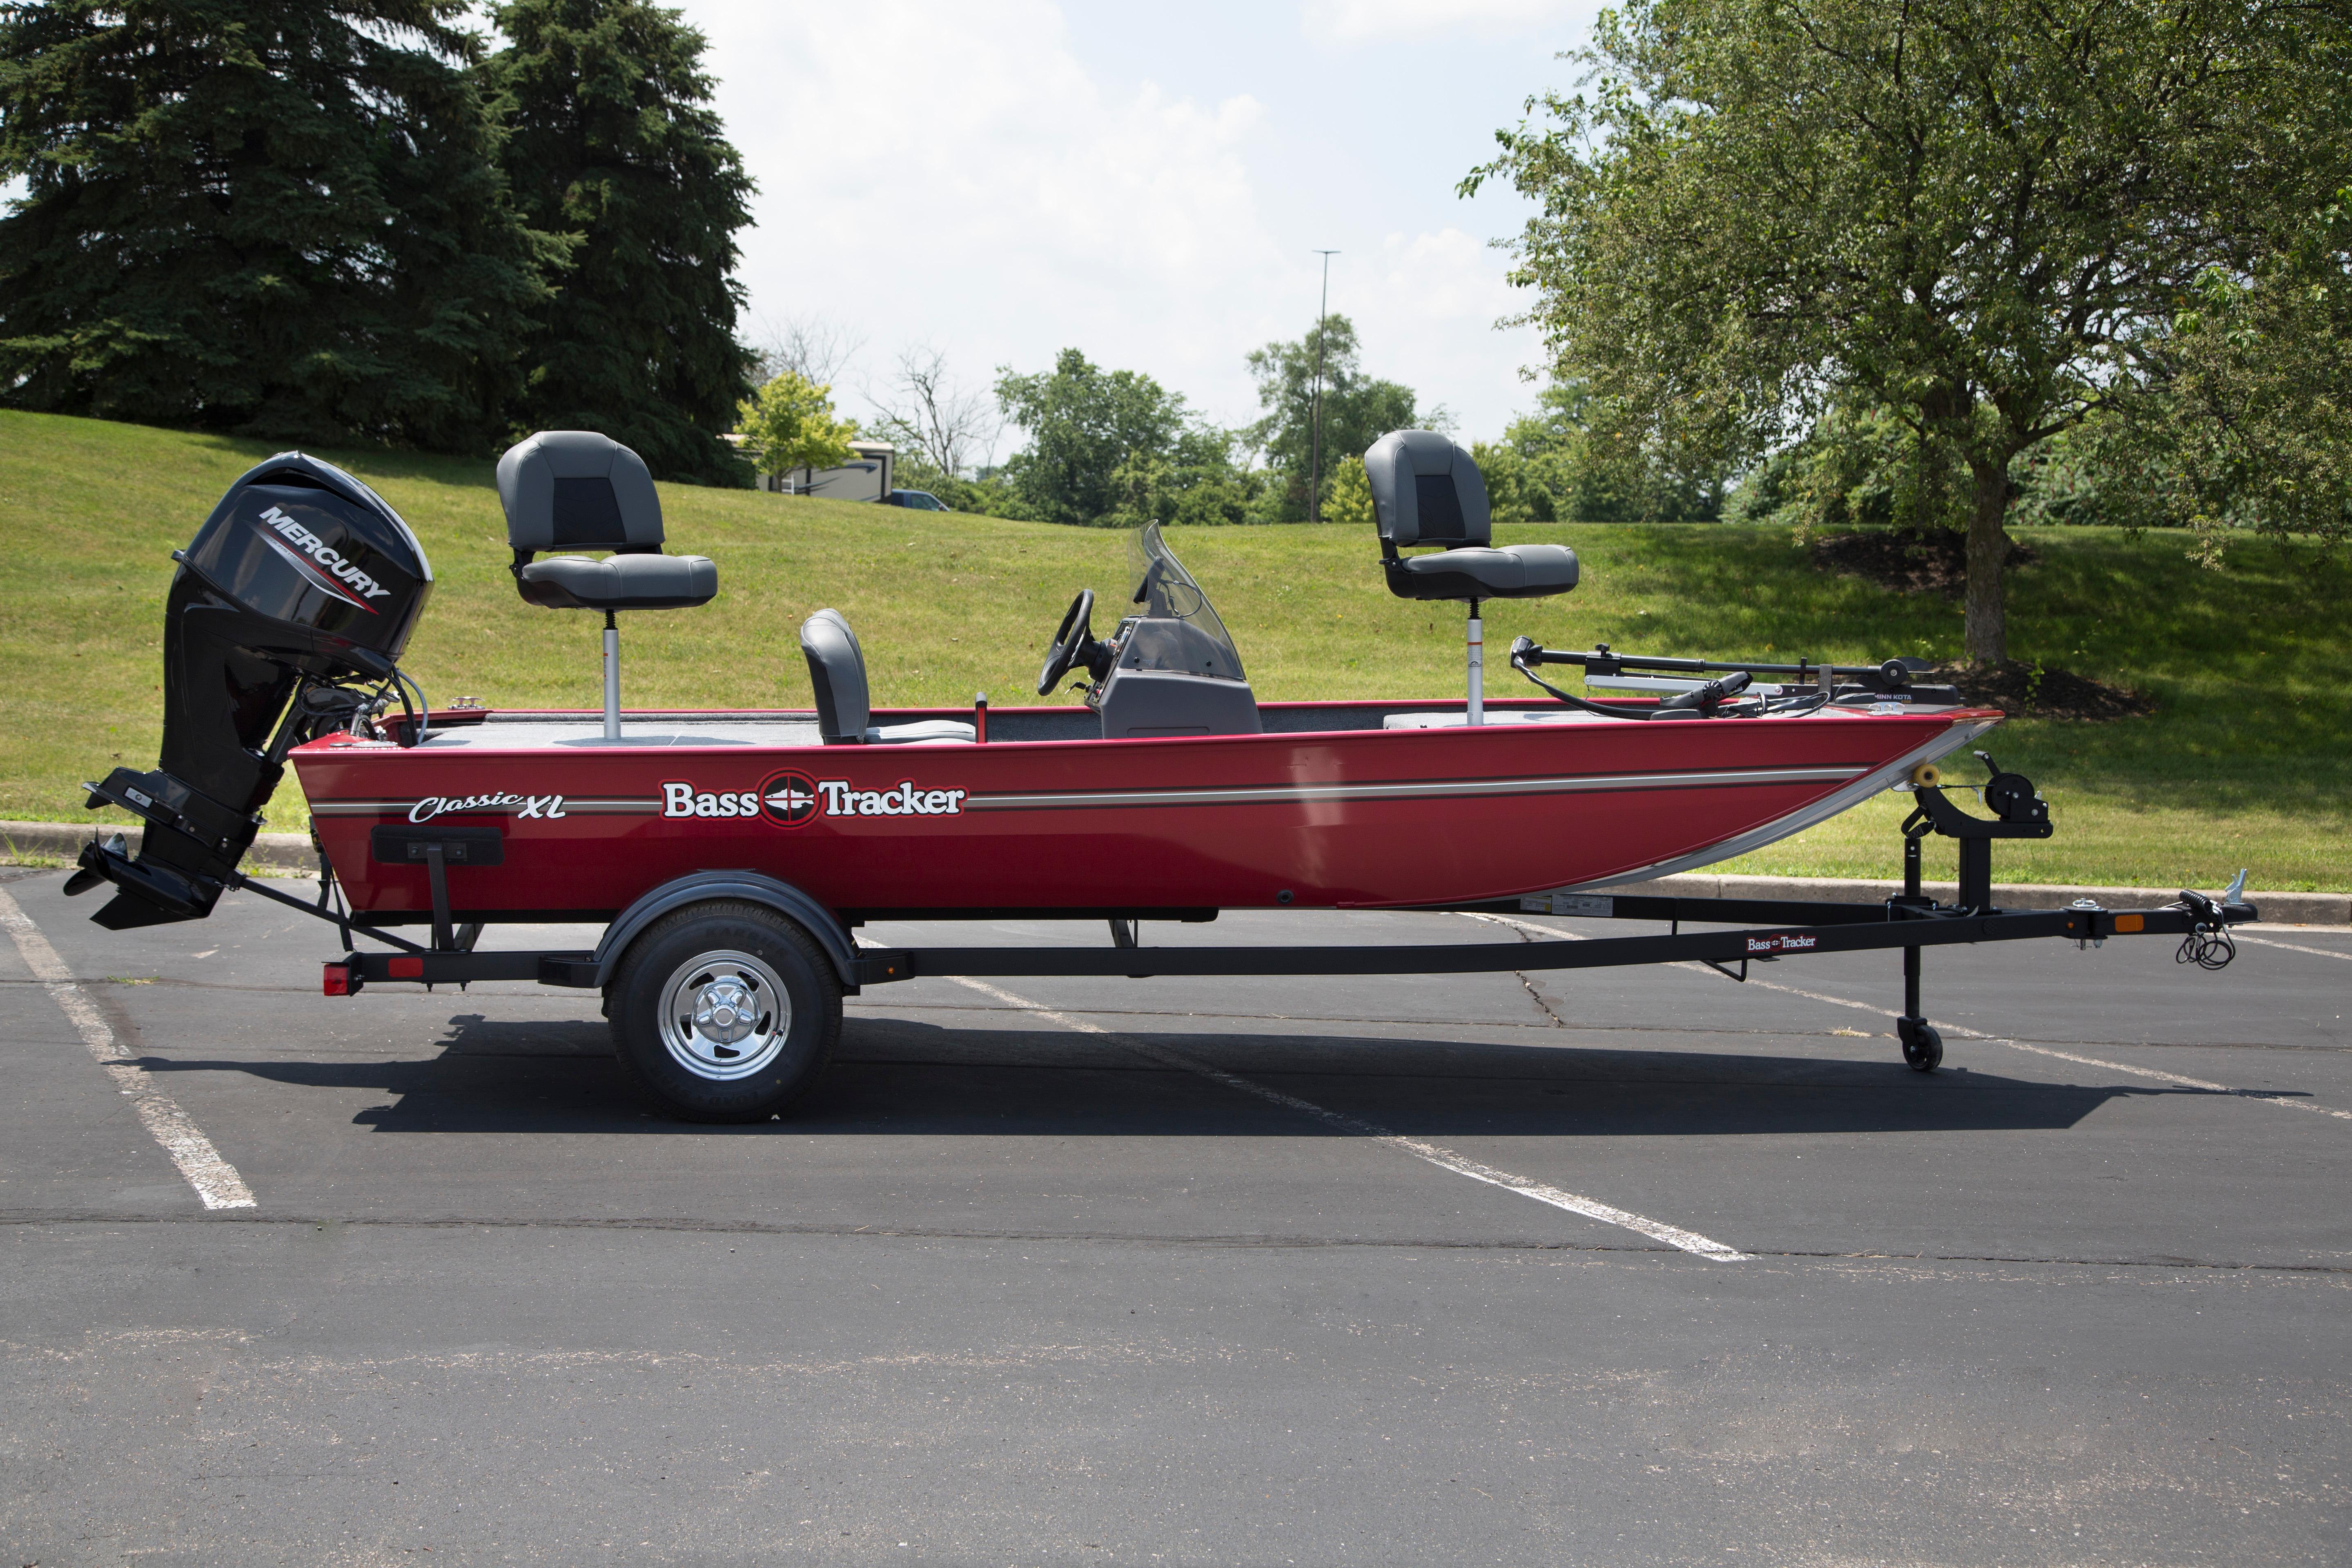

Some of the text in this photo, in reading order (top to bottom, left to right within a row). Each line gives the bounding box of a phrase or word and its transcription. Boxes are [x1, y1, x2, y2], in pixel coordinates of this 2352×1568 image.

[259, 506, 391, 598] MERCURY
[266, 535, 308, 568] FOURSTROKE
[408, 791, 566, 823] Classic XL
[663, 781, 965, 817] Bass Tracker
[1748, 936, 1815, 951] Bass Tracker
